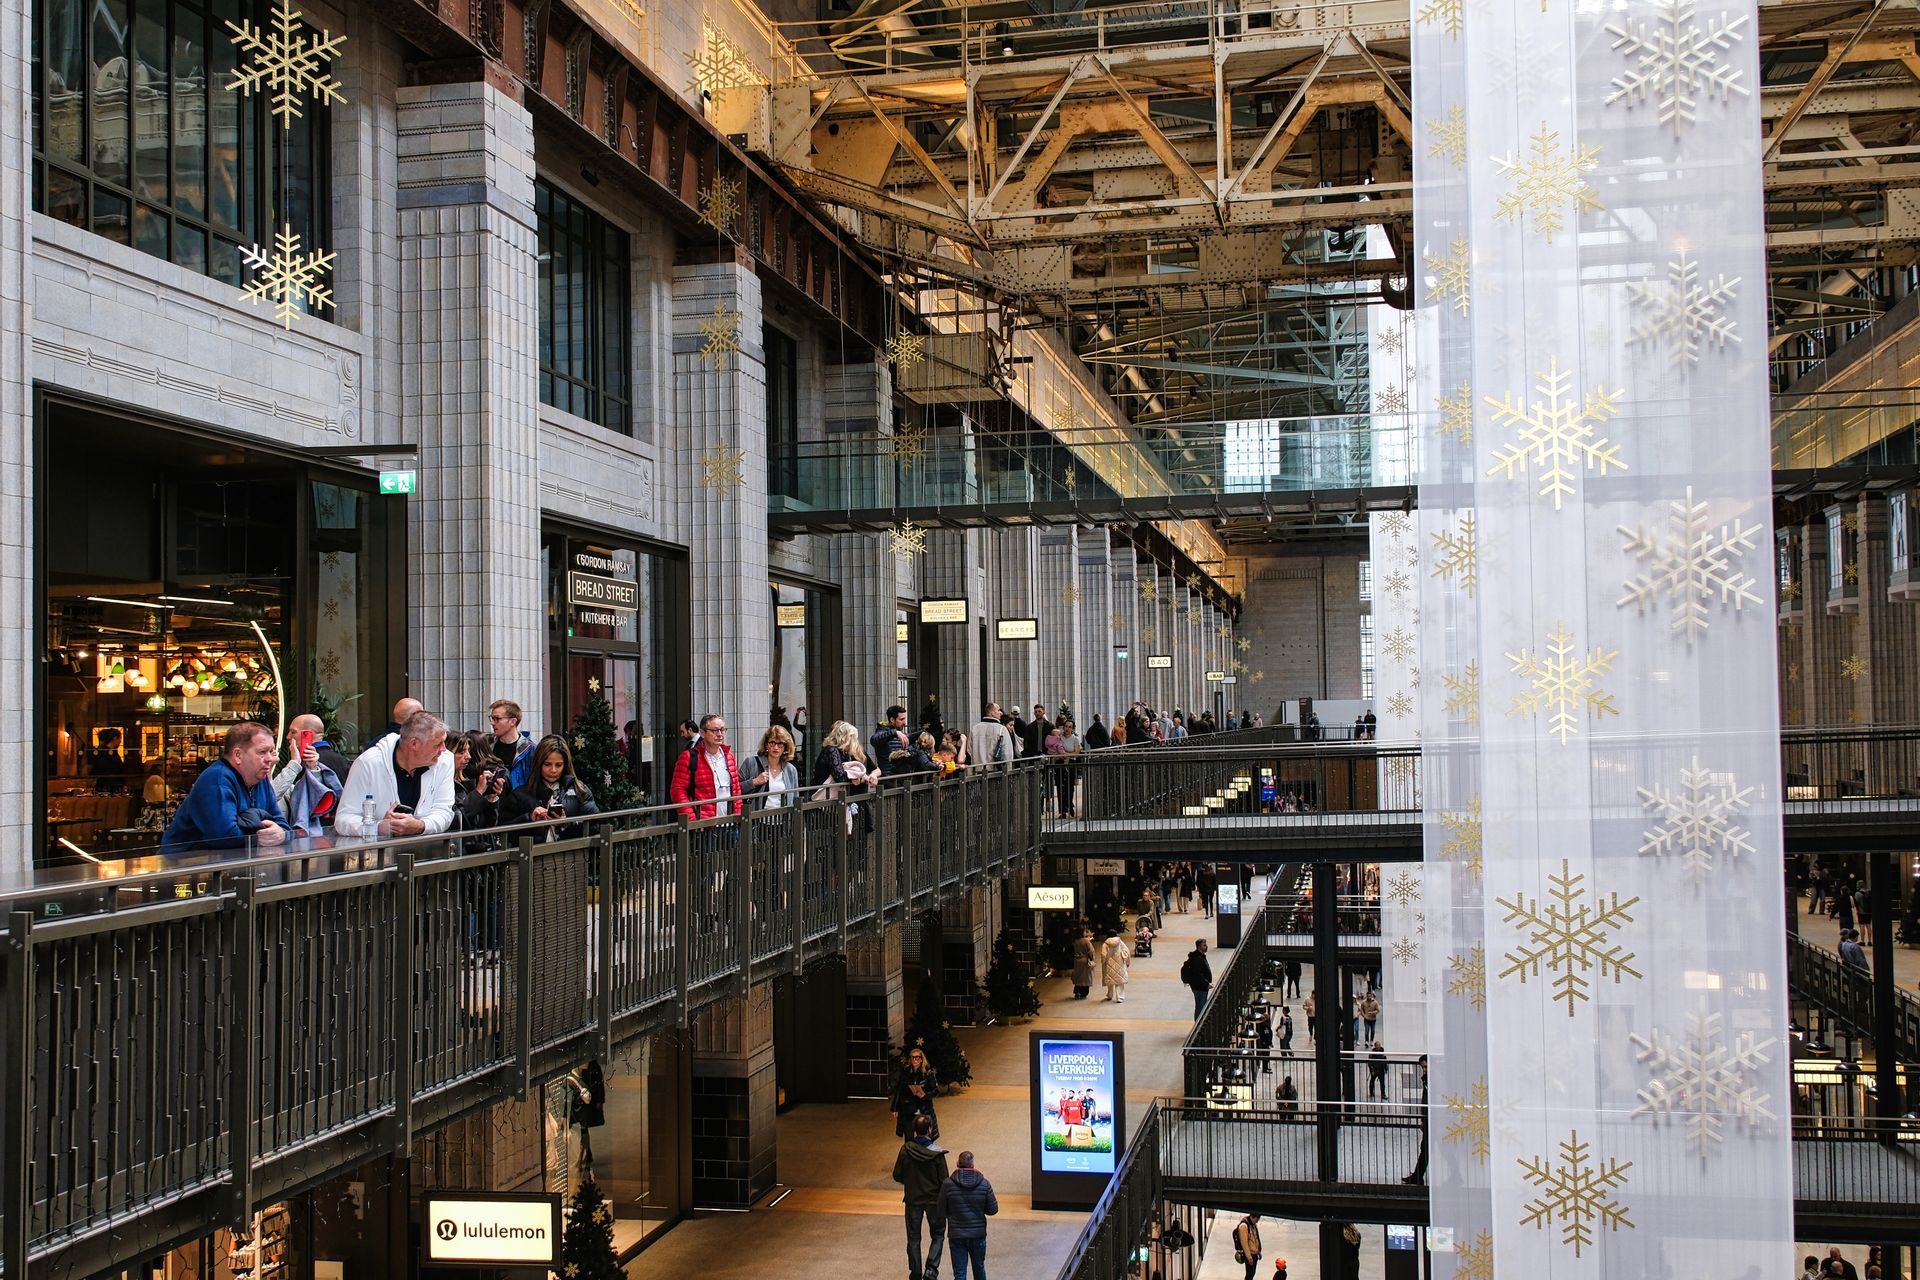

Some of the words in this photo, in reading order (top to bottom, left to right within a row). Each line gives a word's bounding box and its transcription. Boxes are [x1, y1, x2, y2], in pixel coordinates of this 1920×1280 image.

[579, 554, 606, 569] GORDON
[607, 559, 631, 574] RAMSAY
[576, 579, 604, 599] BREAD
[606, 584, 635, 604] STREET
[617, 615, 628, 628] BAR
[1049, 1054, 1097, 1065] LIVERPOOL
[1048, 1064, 1105, 1075] LEVERKUSEN
[463, 1221, 545, 1239] lululemon
